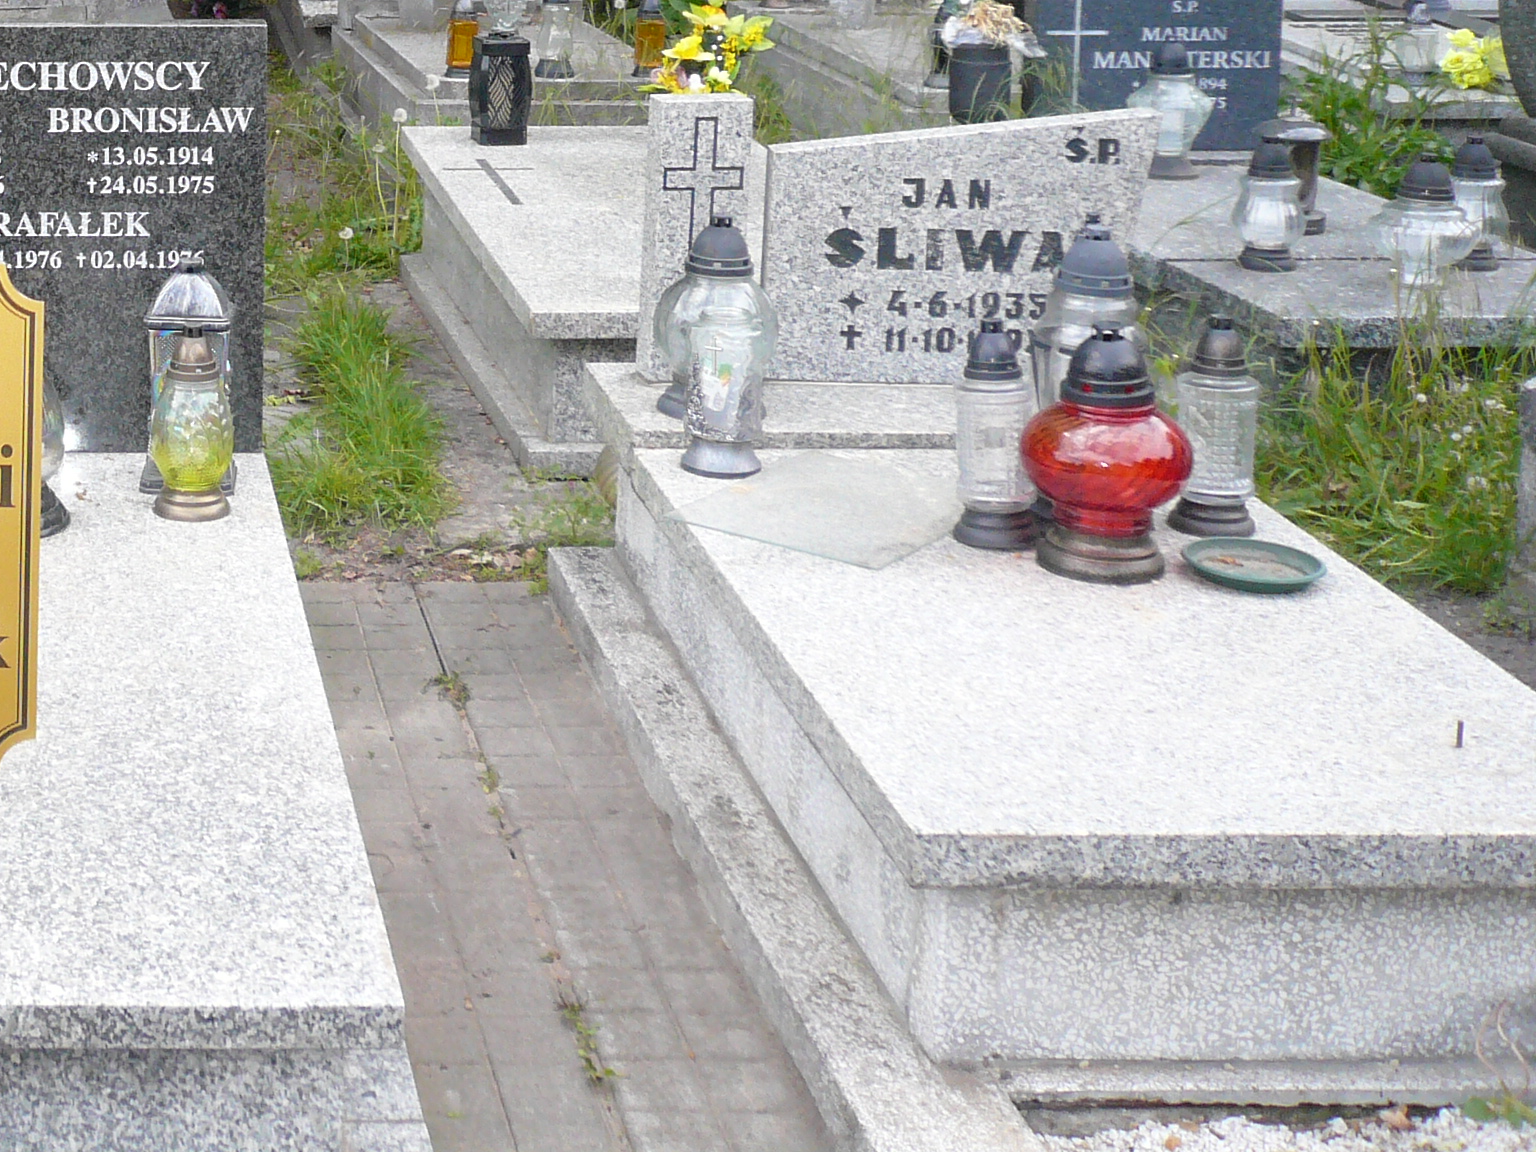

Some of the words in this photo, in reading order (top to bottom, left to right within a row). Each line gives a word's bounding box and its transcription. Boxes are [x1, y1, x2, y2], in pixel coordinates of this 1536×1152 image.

[1141, 26, 1230, 42] MARIAN
[1093, 50, 1272, 70] MANTERSKI
[47, 106, 255, 135] BRONISŁAW
[901, 178, 992, 210] JAN
[824, 205, 1065, 273] ŚLIWA
